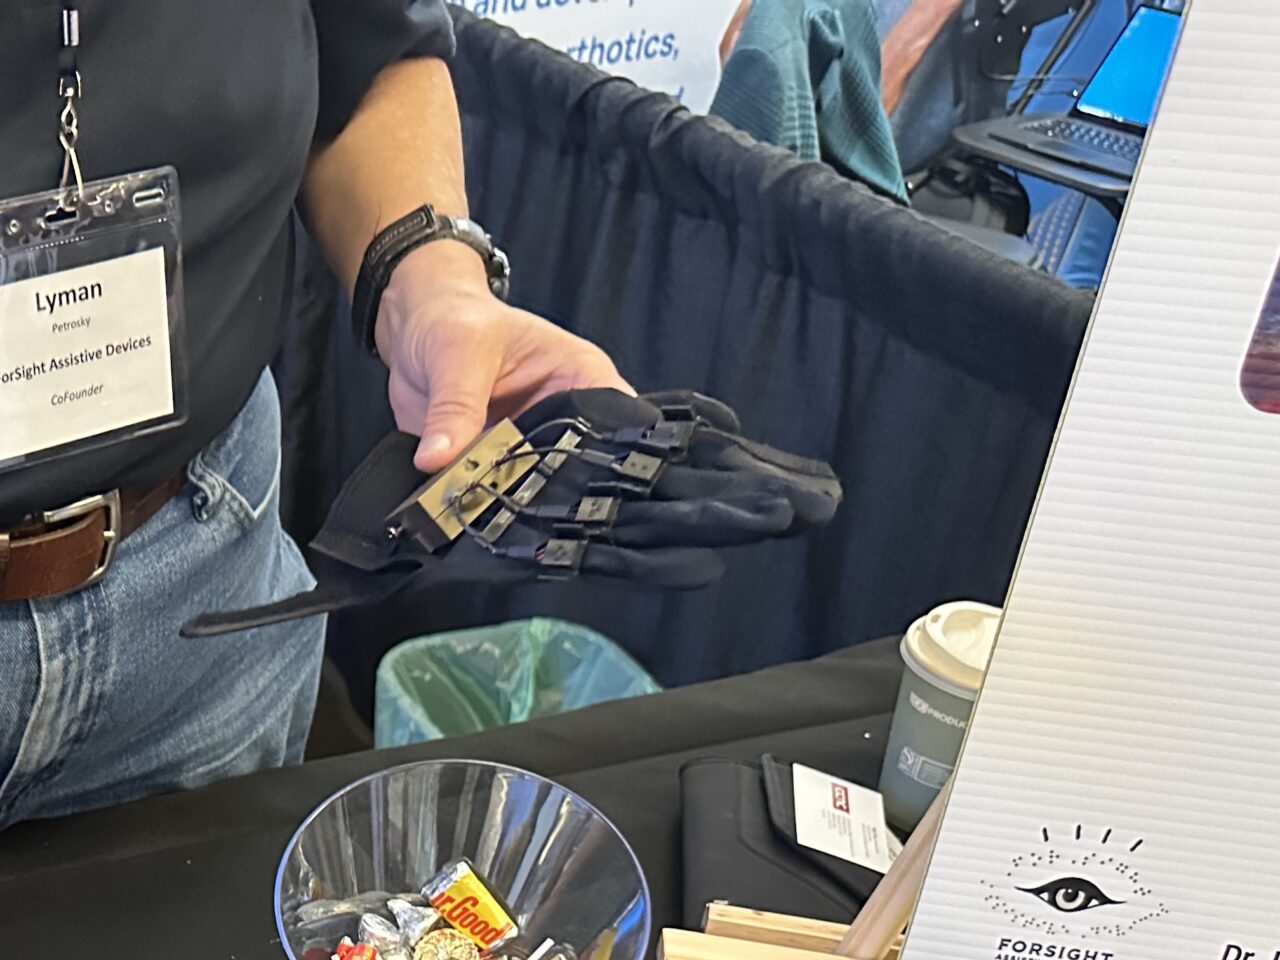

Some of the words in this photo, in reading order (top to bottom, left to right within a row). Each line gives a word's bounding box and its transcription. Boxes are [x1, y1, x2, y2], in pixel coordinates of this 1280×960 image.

[35, 282, 103, 314] Lyman
[52, 316, 91, 334] Petrosky
[49, 349, 103, 372] Assistive
[106, 335, 152, 356] Devices
[51, 383, 104, 406] CoFounder
